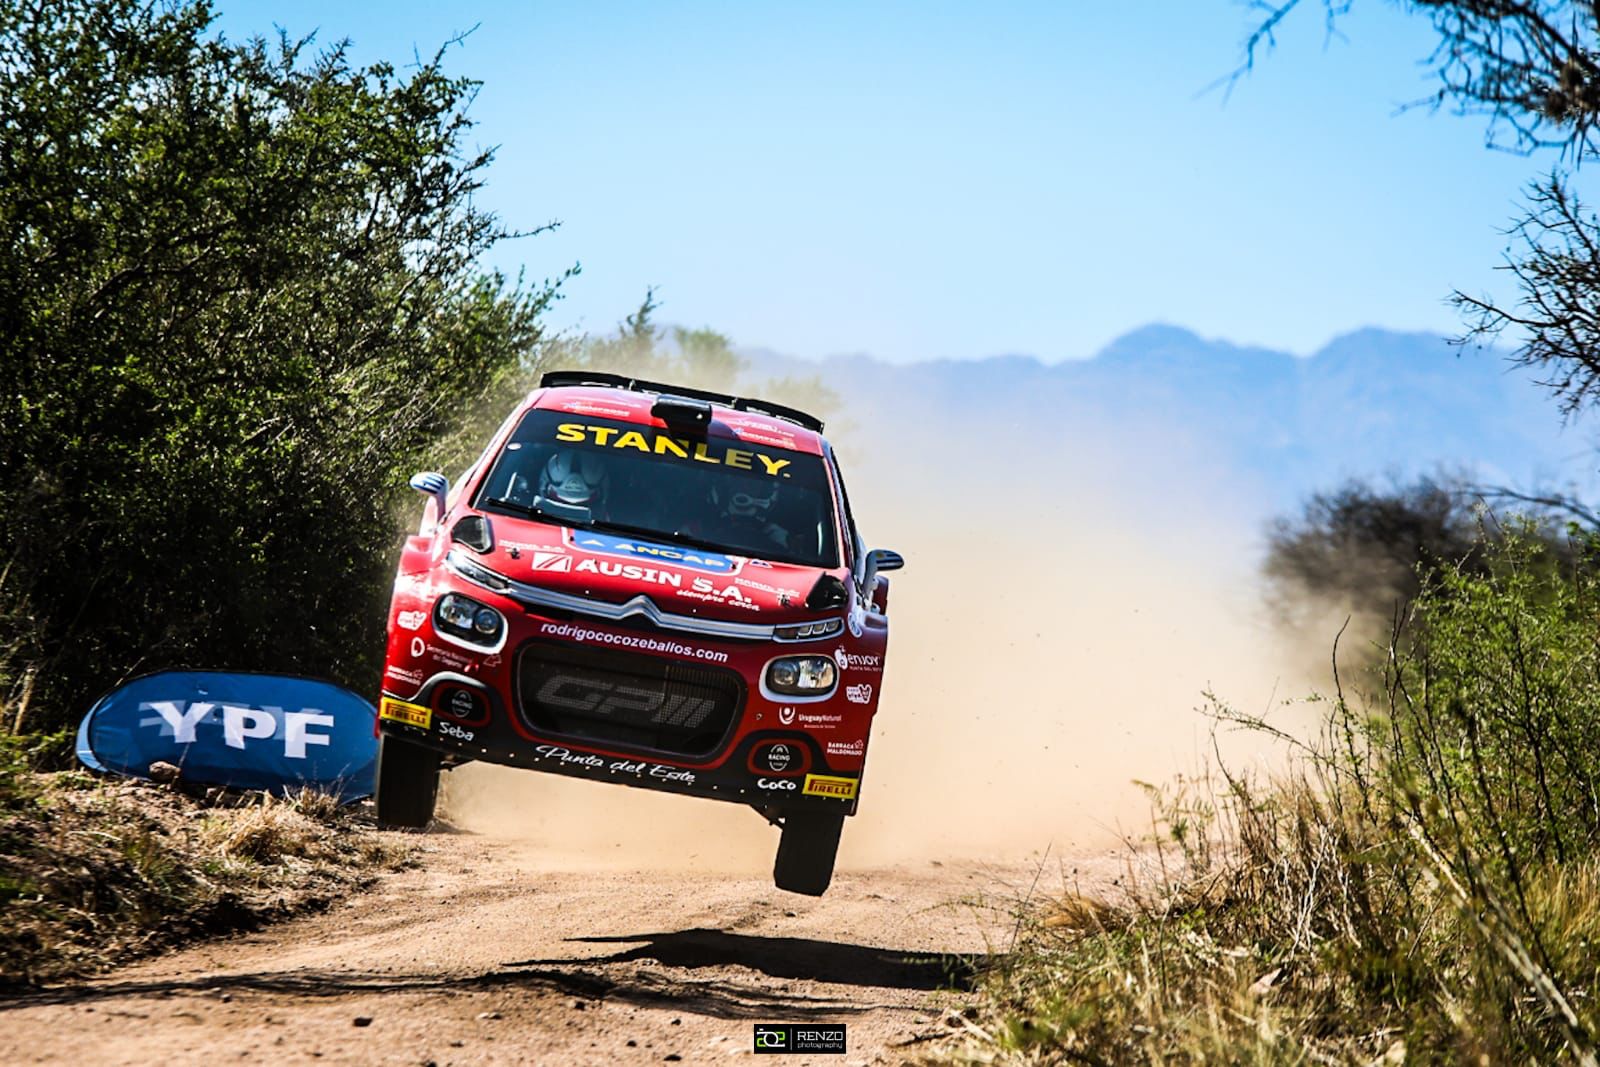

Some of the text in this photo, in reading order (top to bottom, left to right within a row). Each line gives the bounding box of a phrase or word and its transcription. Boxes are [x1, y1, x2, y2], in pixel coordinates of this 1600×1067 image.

[615, 543, 725, 567] ANCAP
[575, 558, 682, 587] AUSIN
[691, 577, 753, 603] S.A.
[676, 589, 760, 612] siempre cerca
[540, 623, 729, 663] rodrigococozeballos.com
[385, 702, 427, 725] PIRELLI
[149, 702, 334, 759] YPF
[439, 721, 475, 741] Seba
[535, 745, 696, 782] Punta del Este
[768, 753, 791, 762] RACING
[808, 778, 853, 795] PIRELLI
